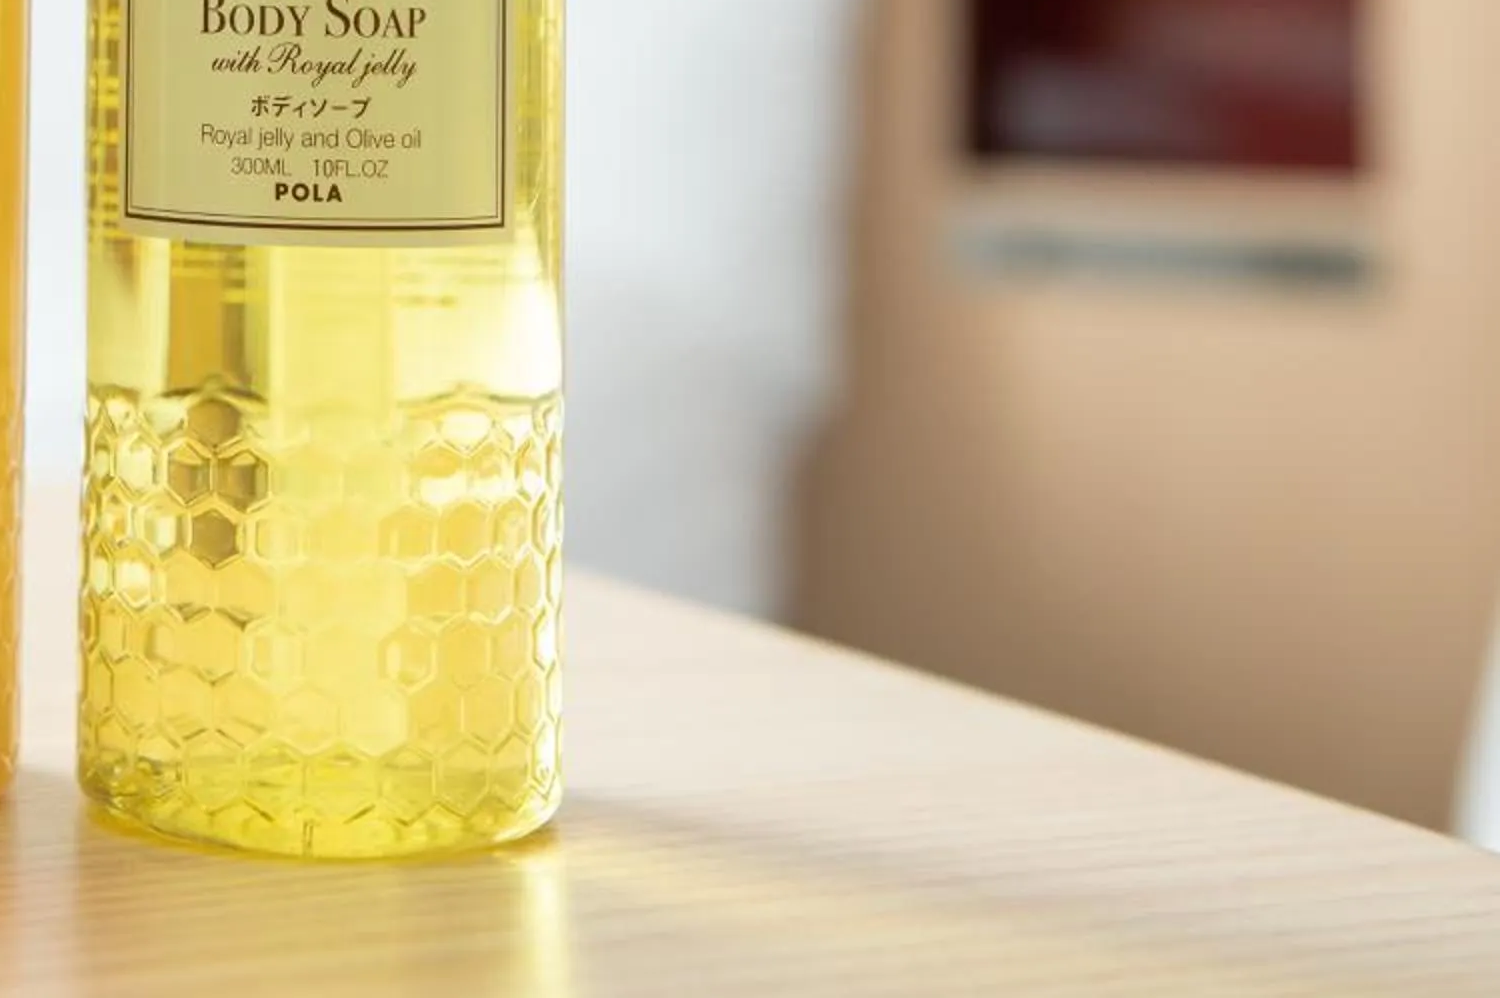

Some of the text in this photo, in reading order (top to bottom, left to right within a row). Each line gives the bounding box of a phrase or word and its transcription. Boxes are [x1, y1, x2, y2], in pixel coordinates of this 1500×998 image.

[212, 42, 417, 88] with Royal jelly
[252, 95, 372, 118] ボディソープ
[201, 123, 421, 151] Royal jelly and Olive oil
[231, 157, 291, 177] 300ML
[275, 183, 343, 202] POLA
